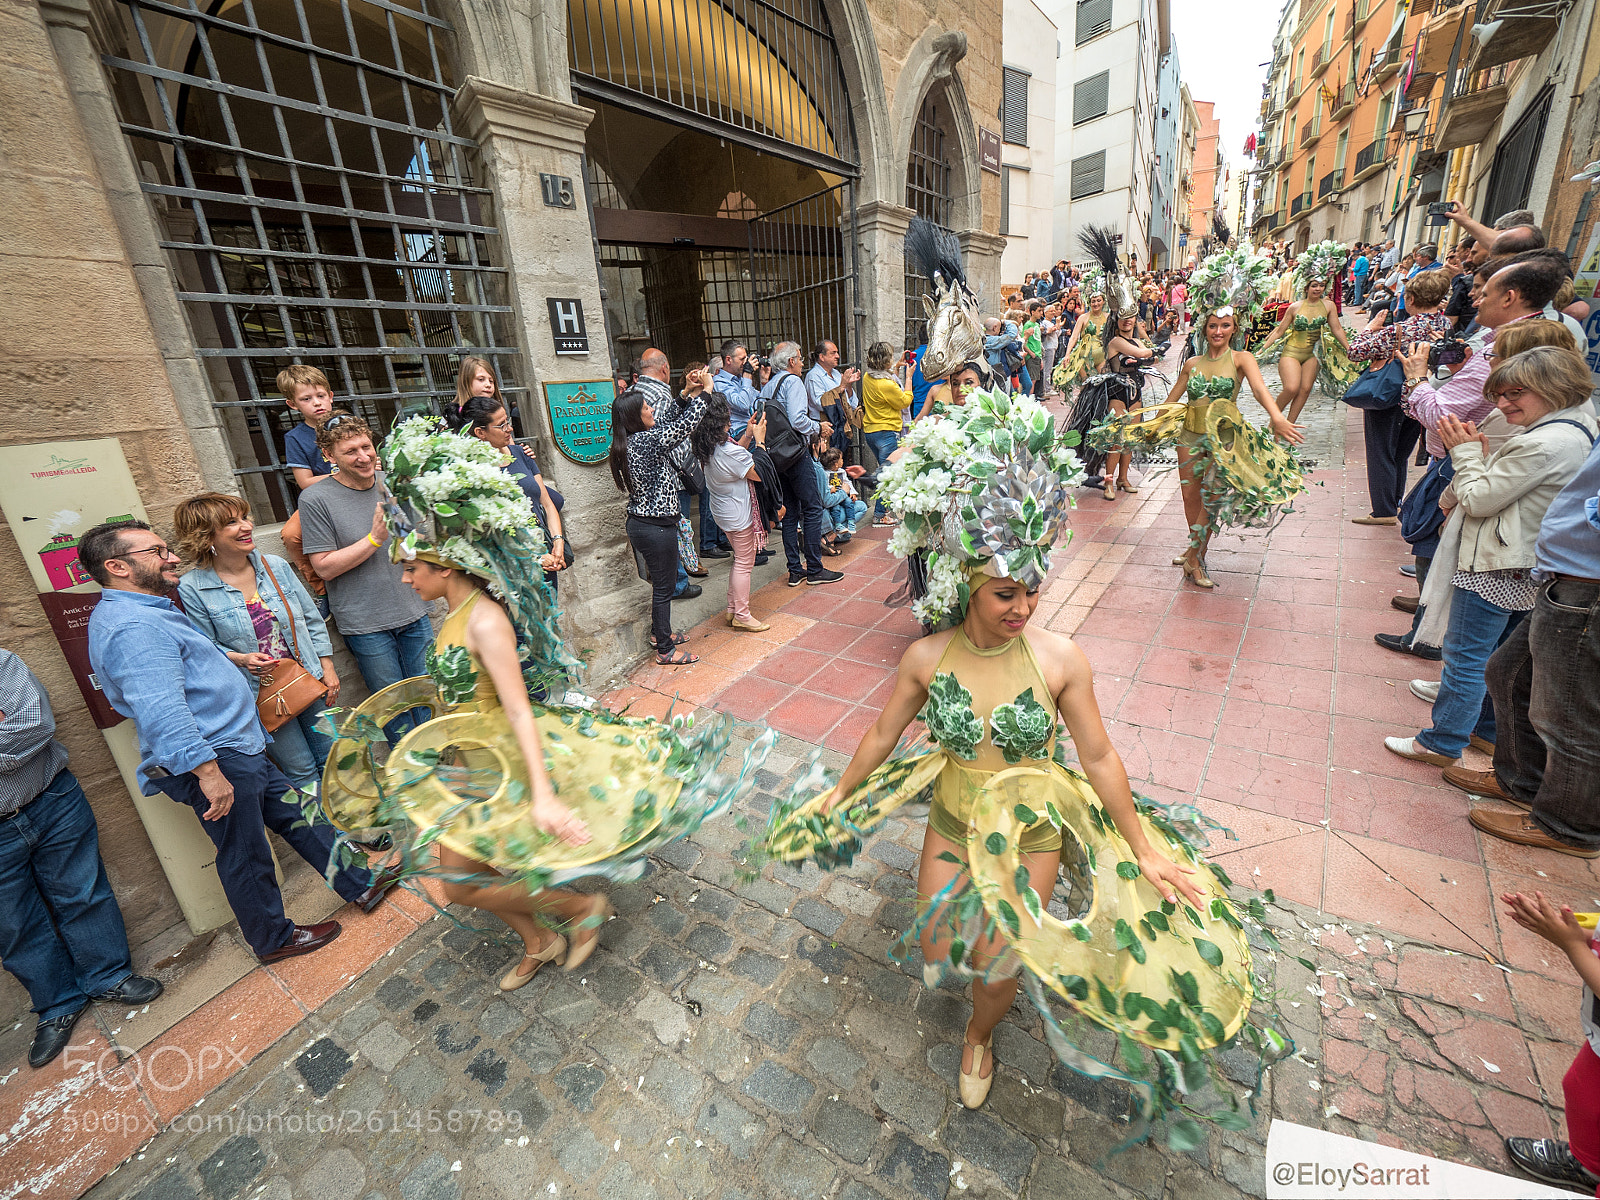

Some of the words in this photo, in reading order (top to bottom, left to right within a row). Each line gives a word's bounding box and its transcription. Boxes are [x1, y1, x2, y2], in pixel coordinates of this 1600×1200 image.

[544, 175, 572, 206] 15
[555, 301, 580, 334] H
[554, 402, 613, 418] PARADORES
[562, 419, 612, 436] HOTELES
[573, 437, 592, 446] DESDE
[63, 607, 82, 615] Antic
